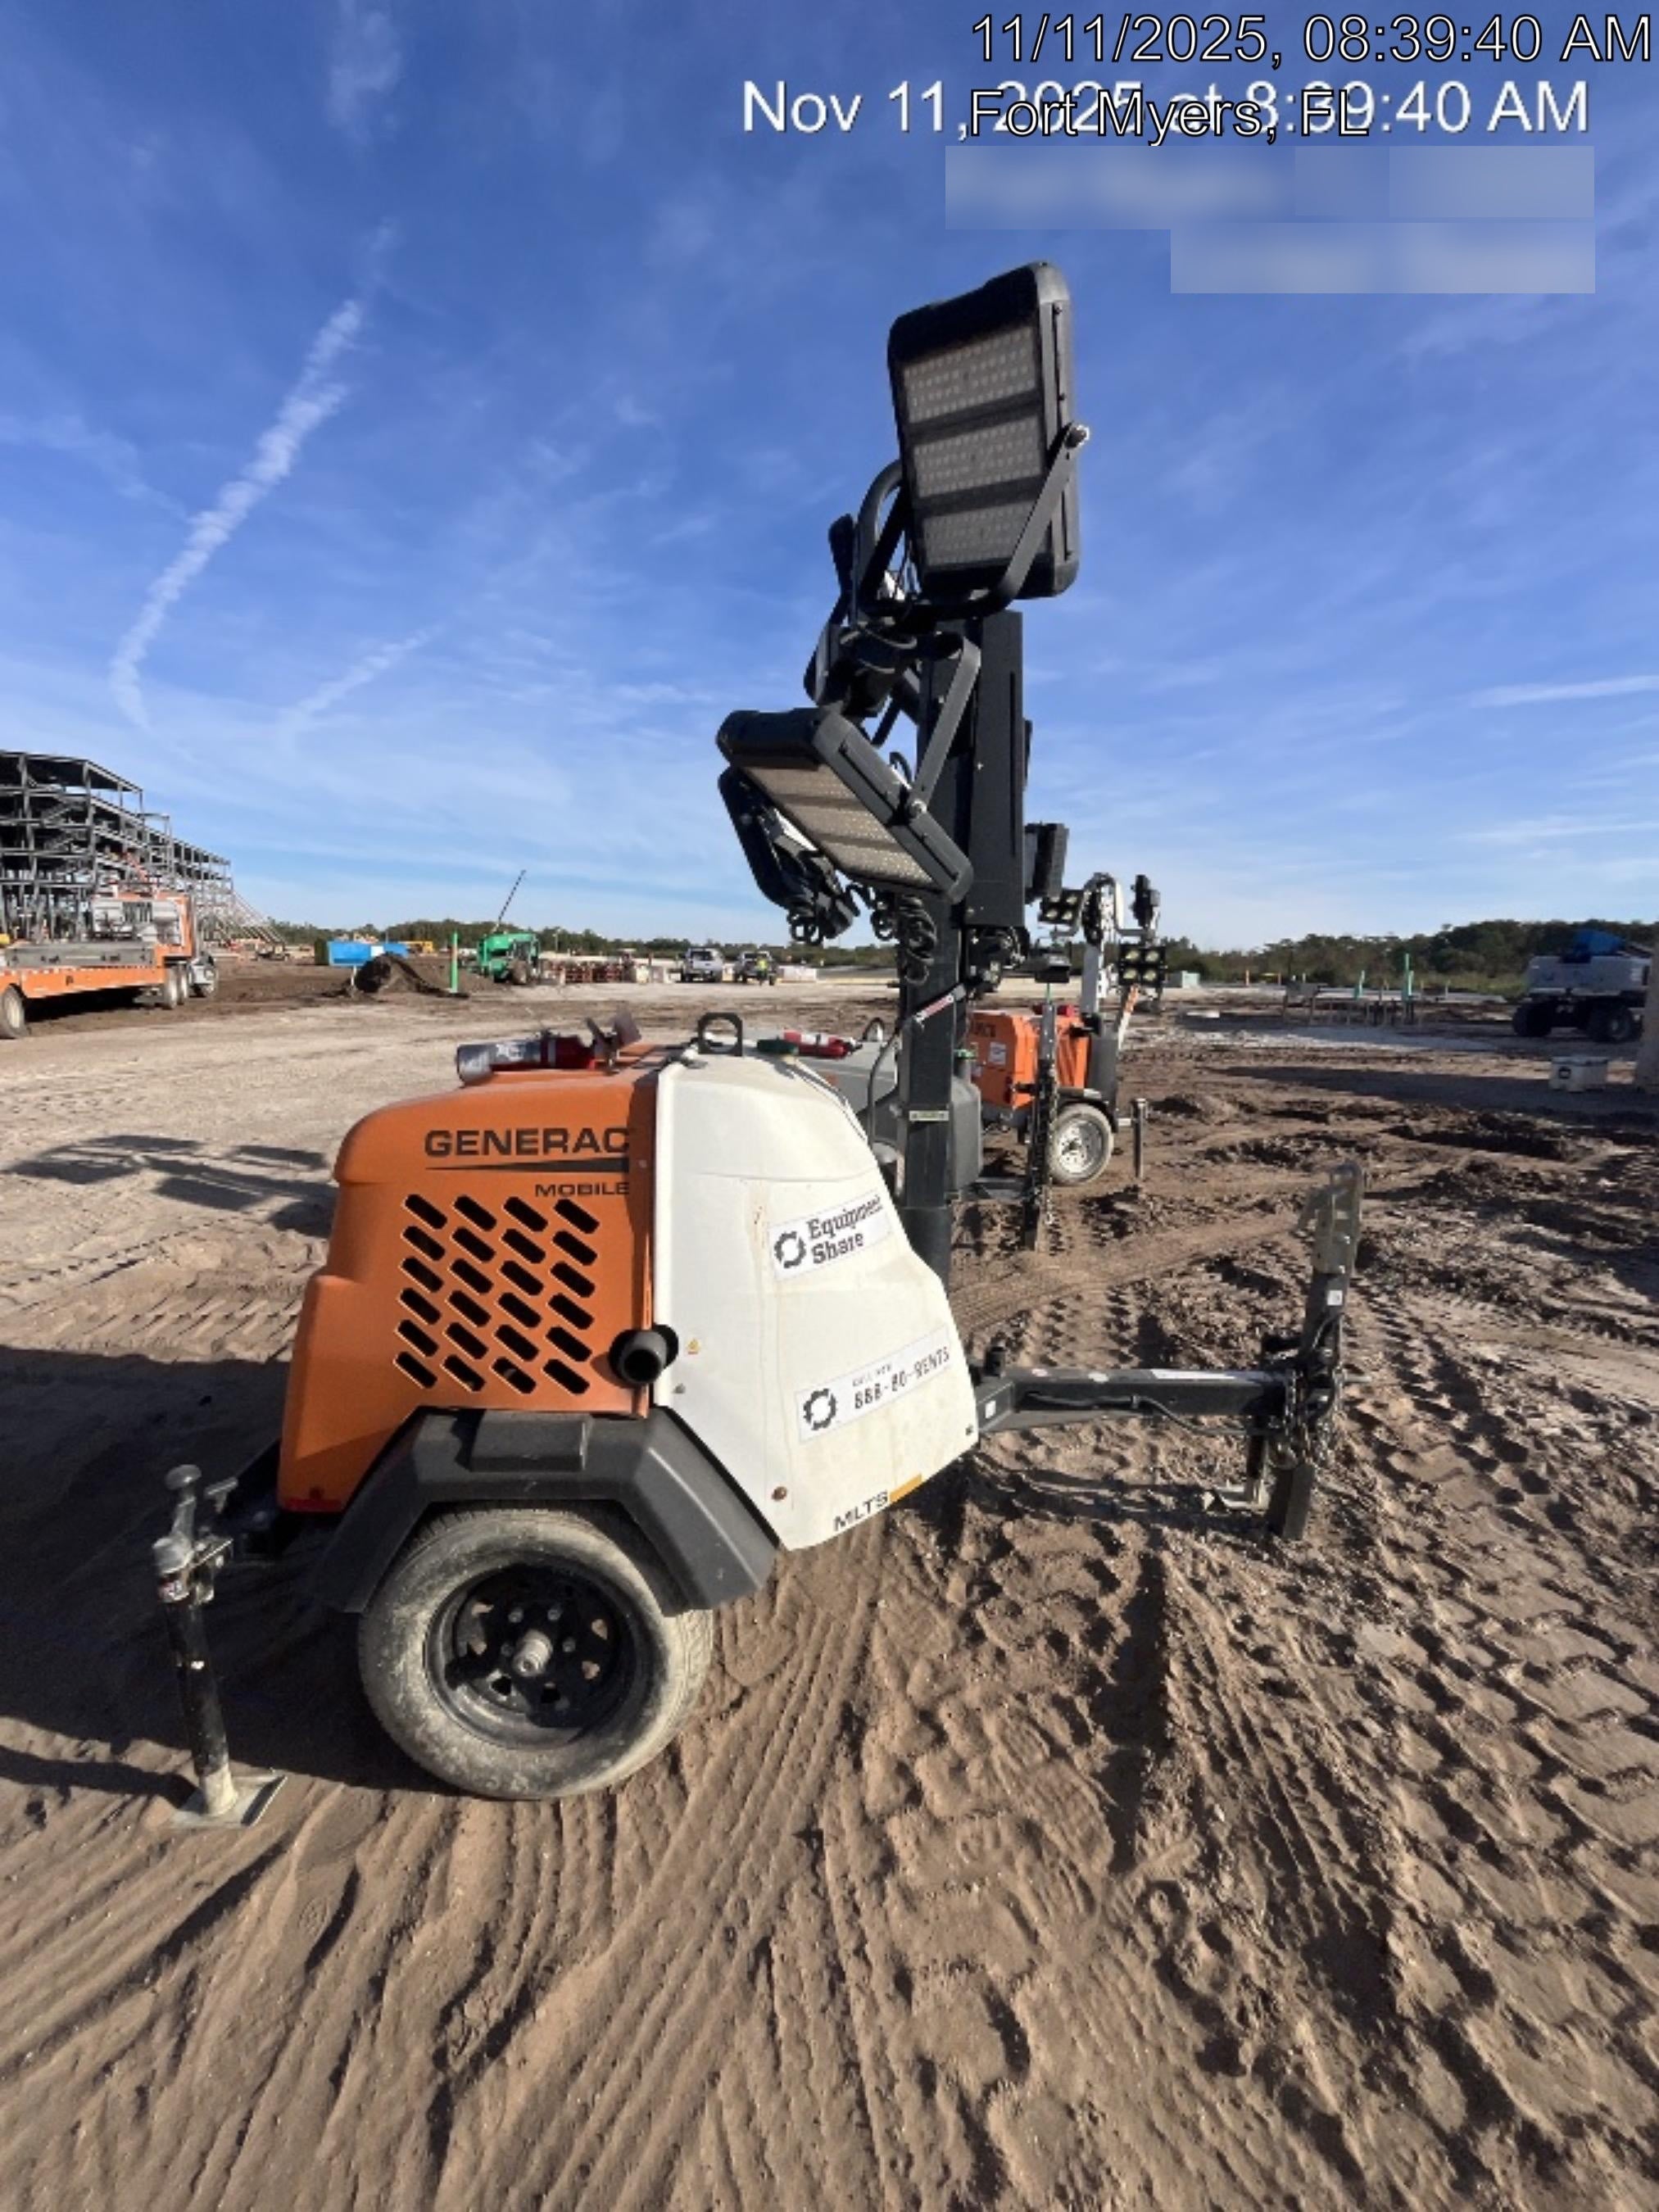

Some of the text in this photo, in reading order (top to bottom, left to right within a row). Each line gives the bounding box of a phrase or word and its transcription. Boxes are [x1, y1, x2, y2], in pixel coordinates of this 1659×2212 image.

[424, 1127, 630, 1158] GENERAC
[534, 1181, 630, 1198] MOBILE
[811, 1233, 864, 1264] Share
[833, 1489, 888, 1531] MLTS
